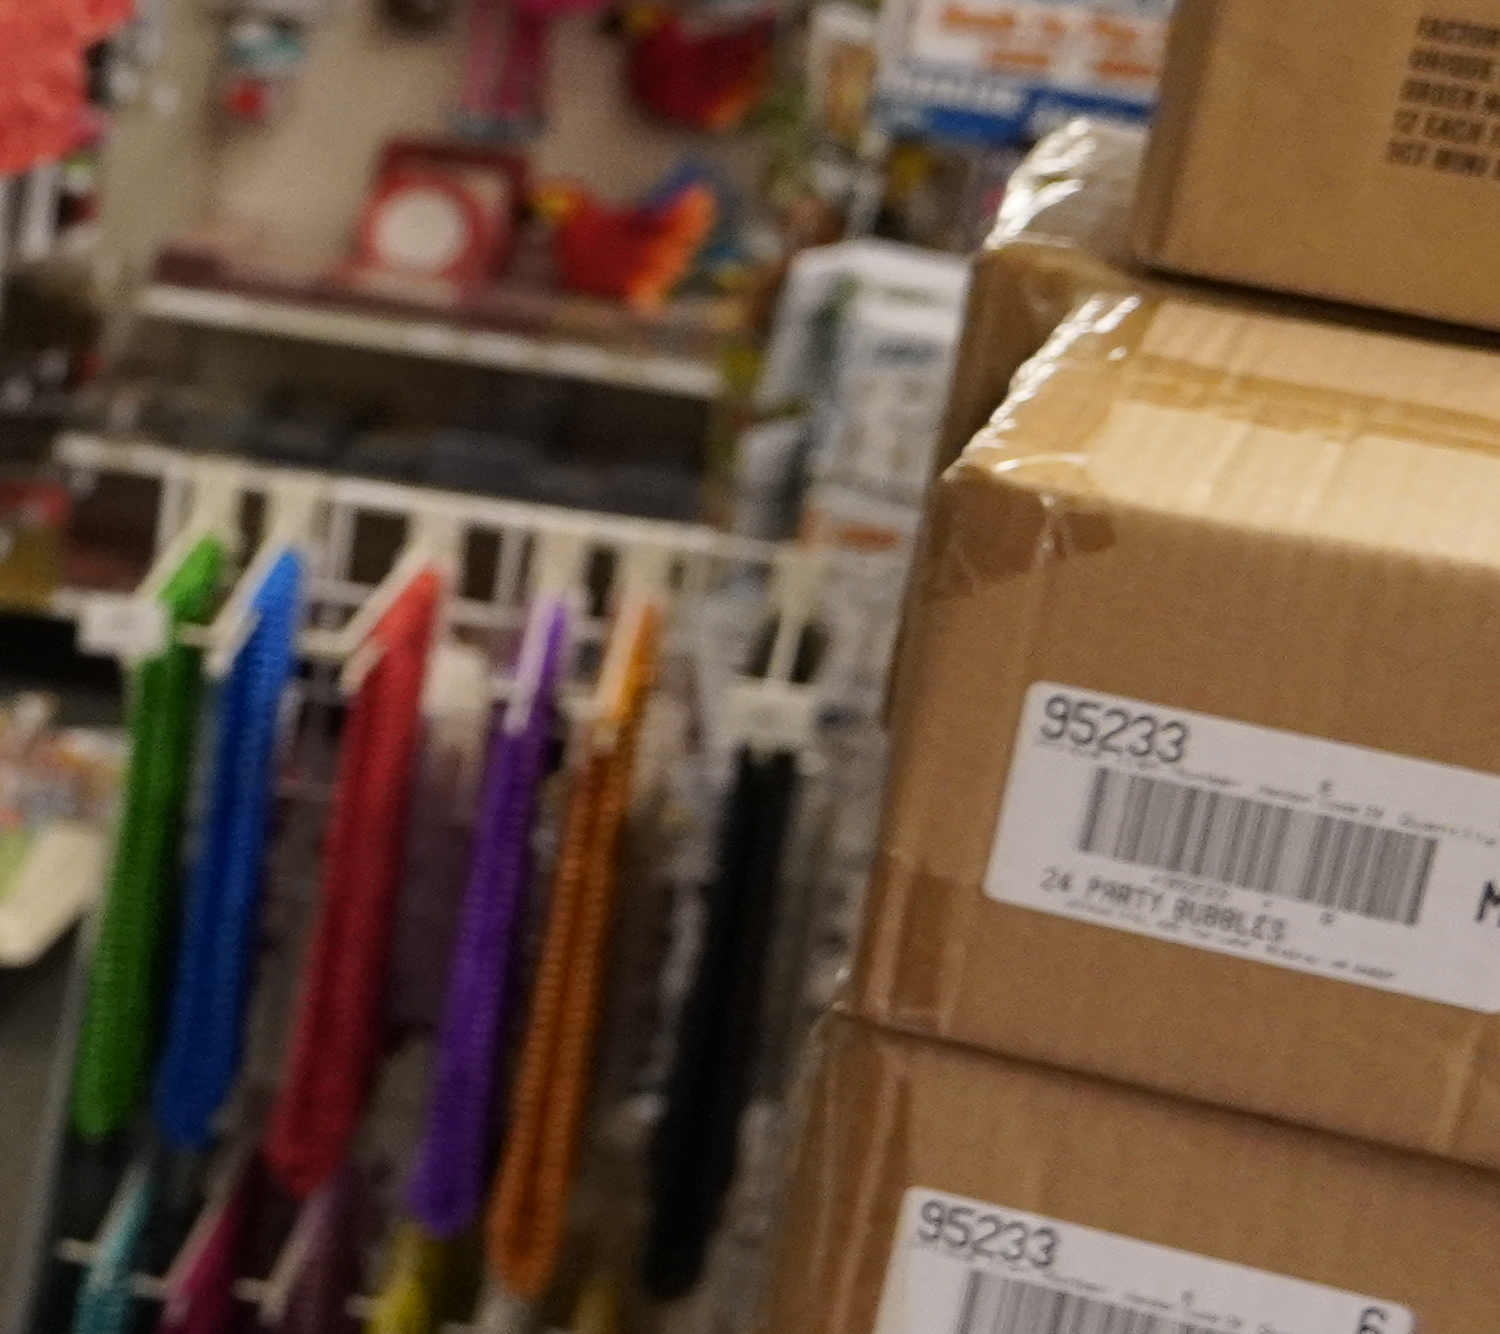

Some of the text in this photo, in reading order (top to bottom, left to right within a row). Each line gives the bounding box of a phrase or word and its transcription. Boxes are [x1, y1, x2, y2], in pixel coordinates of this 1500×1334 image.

[1041, 694, 1190, 763] 95233
[1086, 876, 1166, 913] PARTY
[1172, 899, 1287, 943] BUBBLES
[918, 1199, 1058, 1267] 95233
